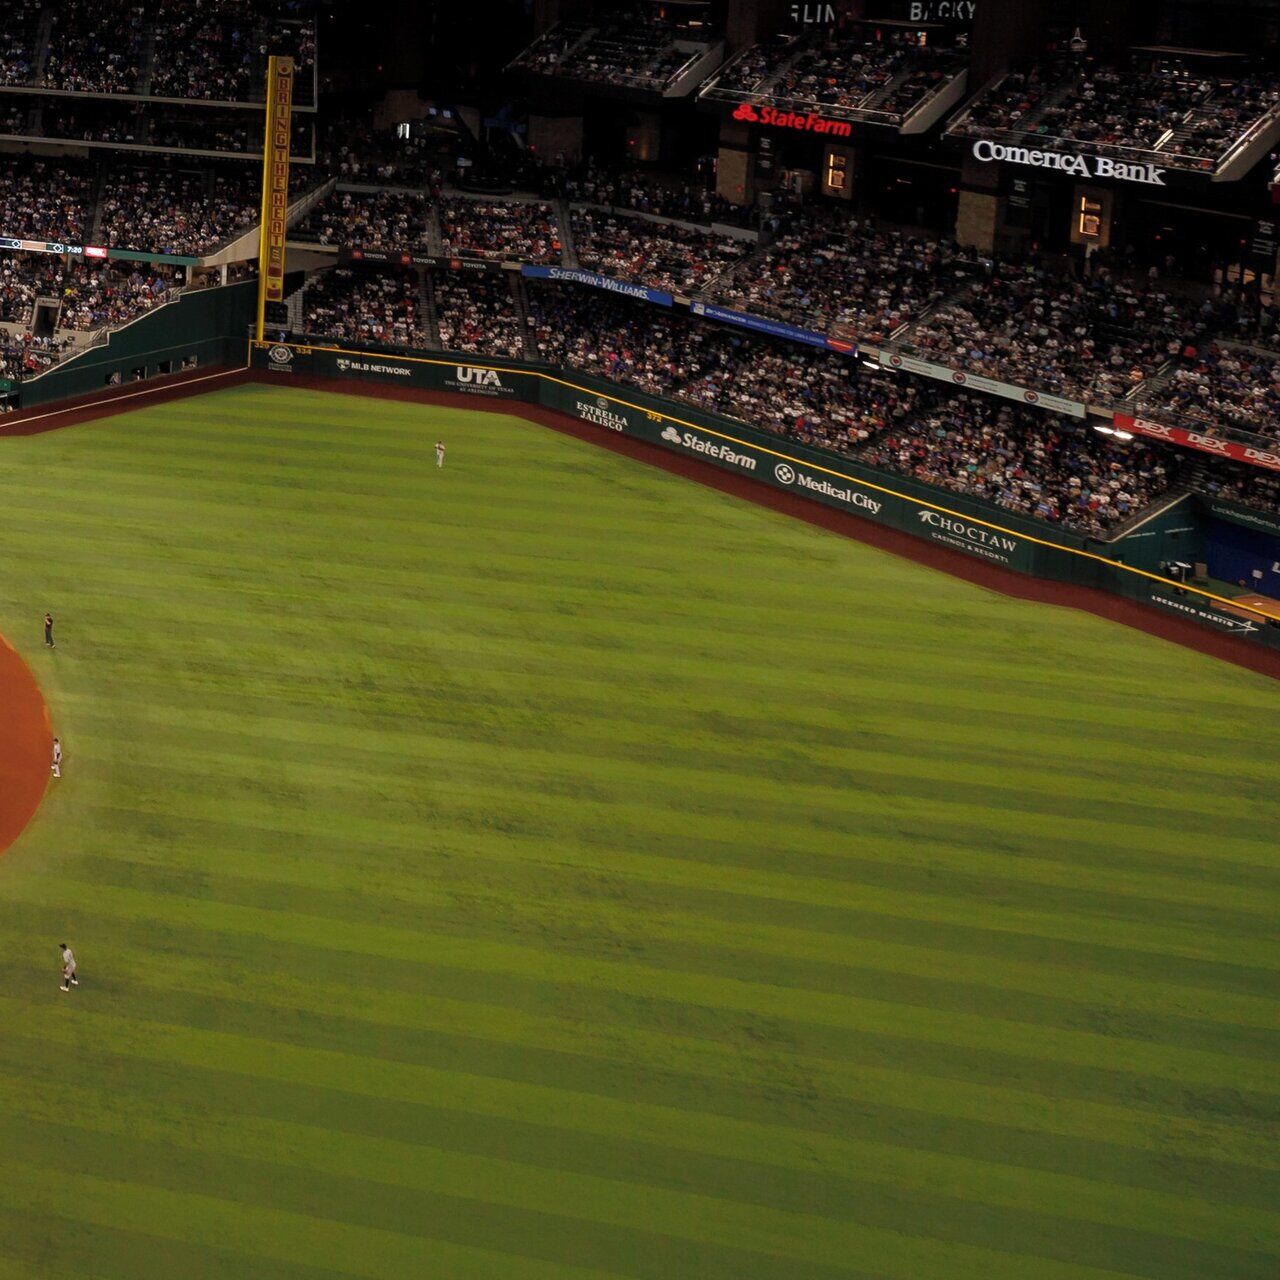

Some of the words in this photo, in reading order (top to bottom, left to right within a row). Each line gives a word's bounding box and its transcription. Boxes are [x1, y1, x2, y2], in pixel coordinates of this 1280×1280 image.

[274, 78, 289, 146] BRING
[273, 148, 288, 190] THE
[1094, 157, 1167, 187] Bank
[270, 193, 286, 247] HEAT
[412, 257, 436, 265] TOYOTA
[463, 262, 486, 270] TOYOTA
[296, 347, 311, 355] 334
[371, 365, 411, 376] NETWORK
[457, 367, 501, 387] UTA
[577, 401, 628, 426] ESTRELLA
[580, 411, 622, 432] JALISCO
[646, 411, 662, 422] 372
[1133, 419, 1172, 436] DEX
[1188, 433, 1228, 451] DEX
[1244, 448, 1280, 465] DEX
[927, 512, 1017, 552] CHOCTAW
[932, 532, 966, 549] CASINOS
[974, 546, 1008, 563] RESORTS
[1152, 595, 1196, 614] LOCKHEED
[1199, 611, 1234, 626] MARTIN
